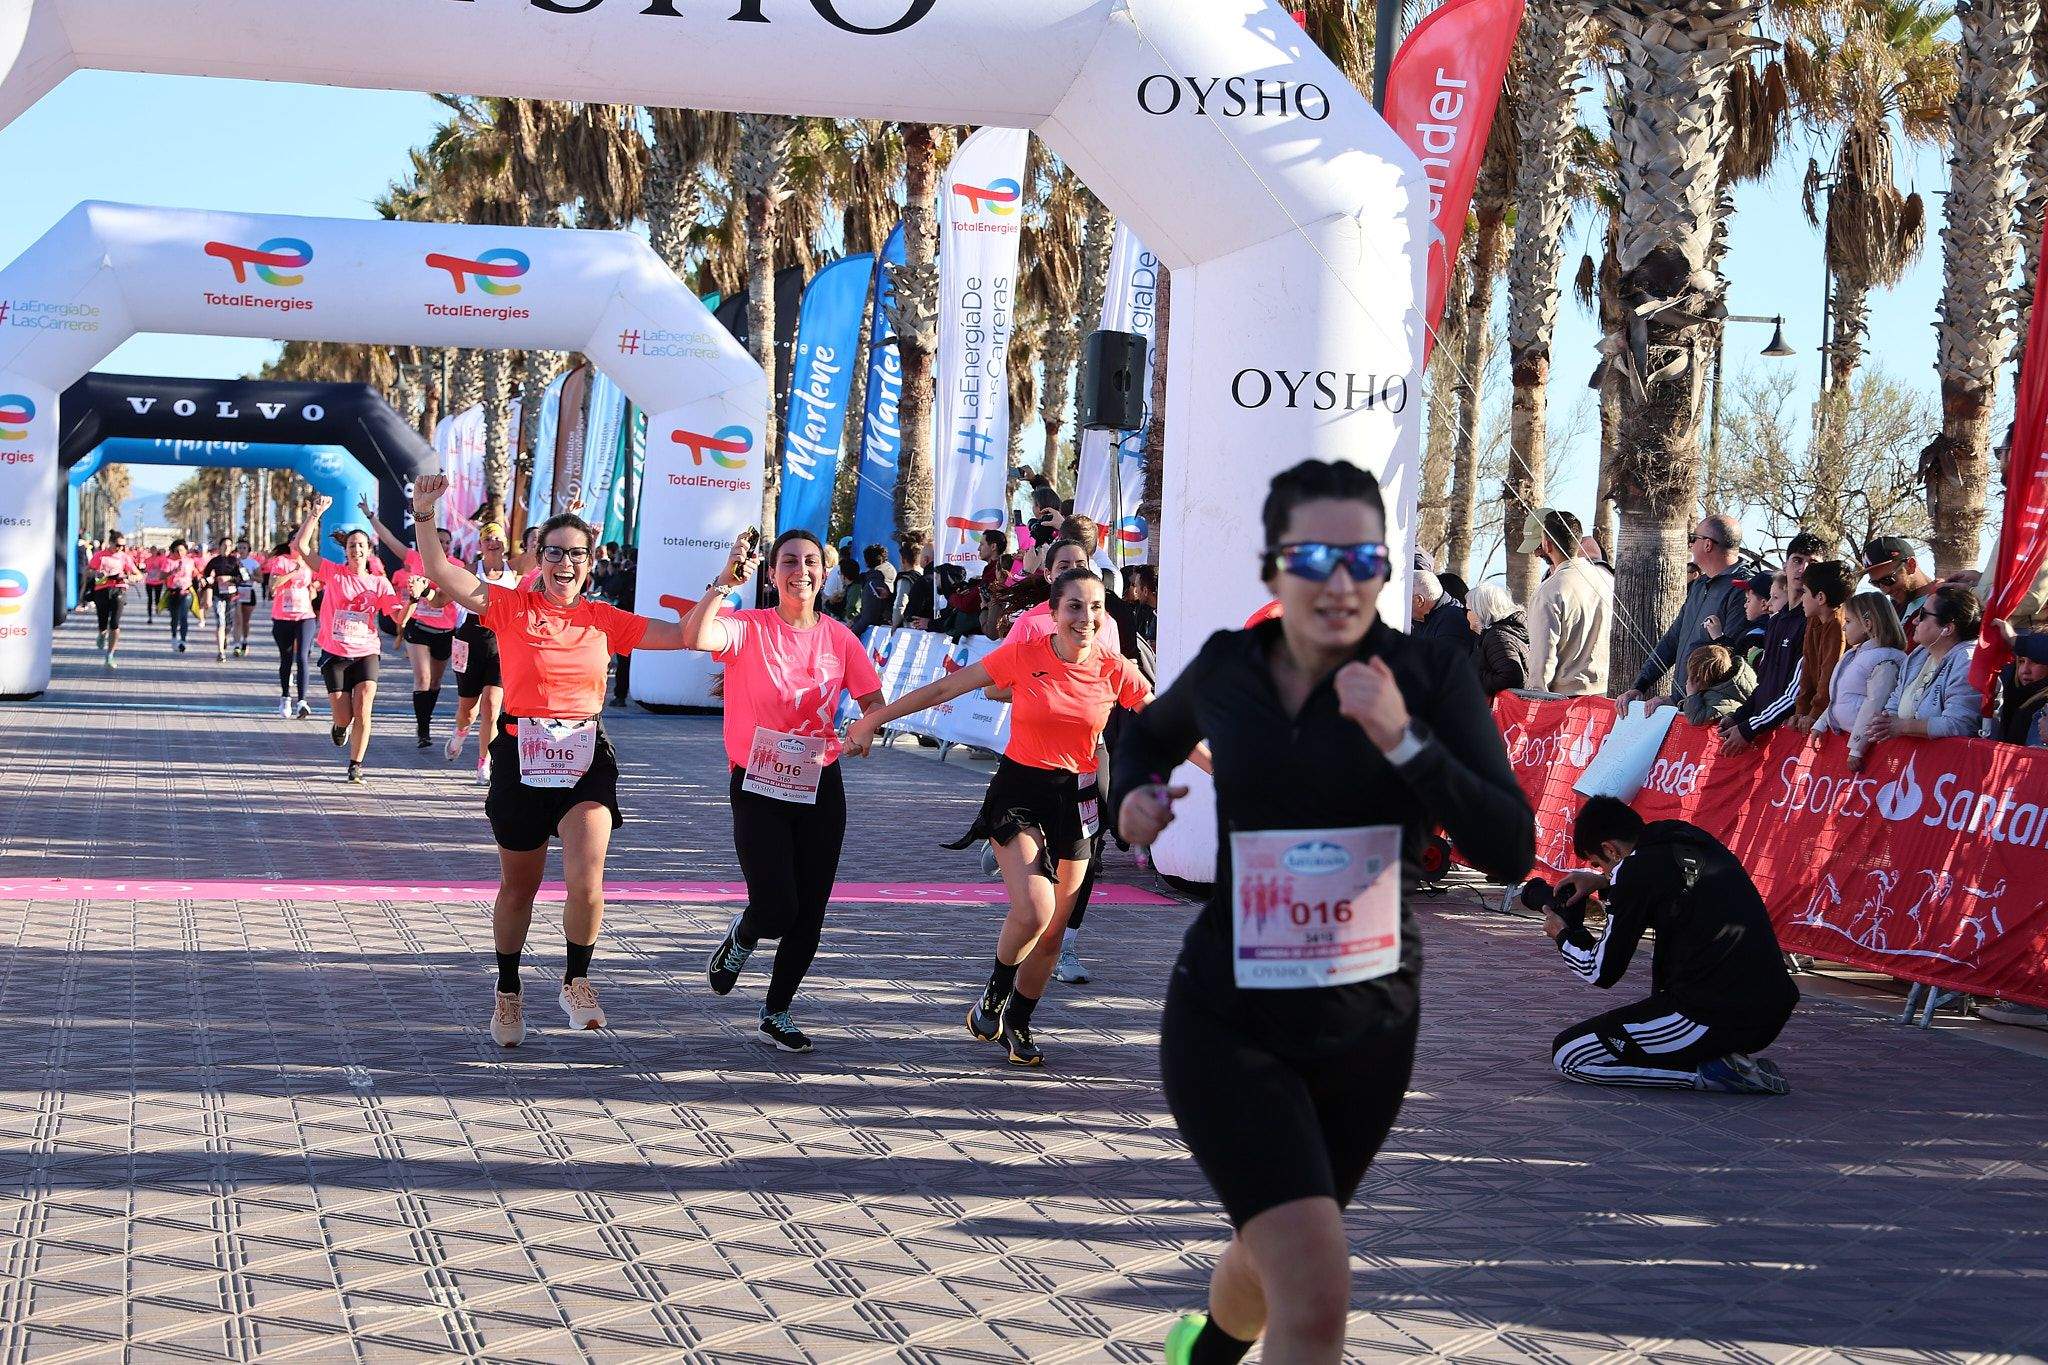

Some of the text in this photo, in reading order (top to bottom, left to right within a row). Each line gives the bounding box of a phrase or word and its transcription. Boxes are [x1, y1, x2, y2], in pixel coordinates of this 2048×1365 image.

[1137, 74, 1331, 121] OYSHO
[952, 222, 1018, 234] TotalEnergies
[204, 293, 313, 312] TotalEnergies
[424, 304, 530, 321] TotalEnergies
[1230, 368, 1409, 414] OYSHO
[127, 396, 325, 422] VOLVO
[786, 345, 841, 481] Marlene
[668, 474, 751, 492] TotalEnergies
[545, 748, 575, 761] 016
[1504, 723, 1571, 771] Sports
[774, 762, 802, 776] 016
[1771, 756, 1878, 823] Sports
[1290, 900, 1354, 926] 016
